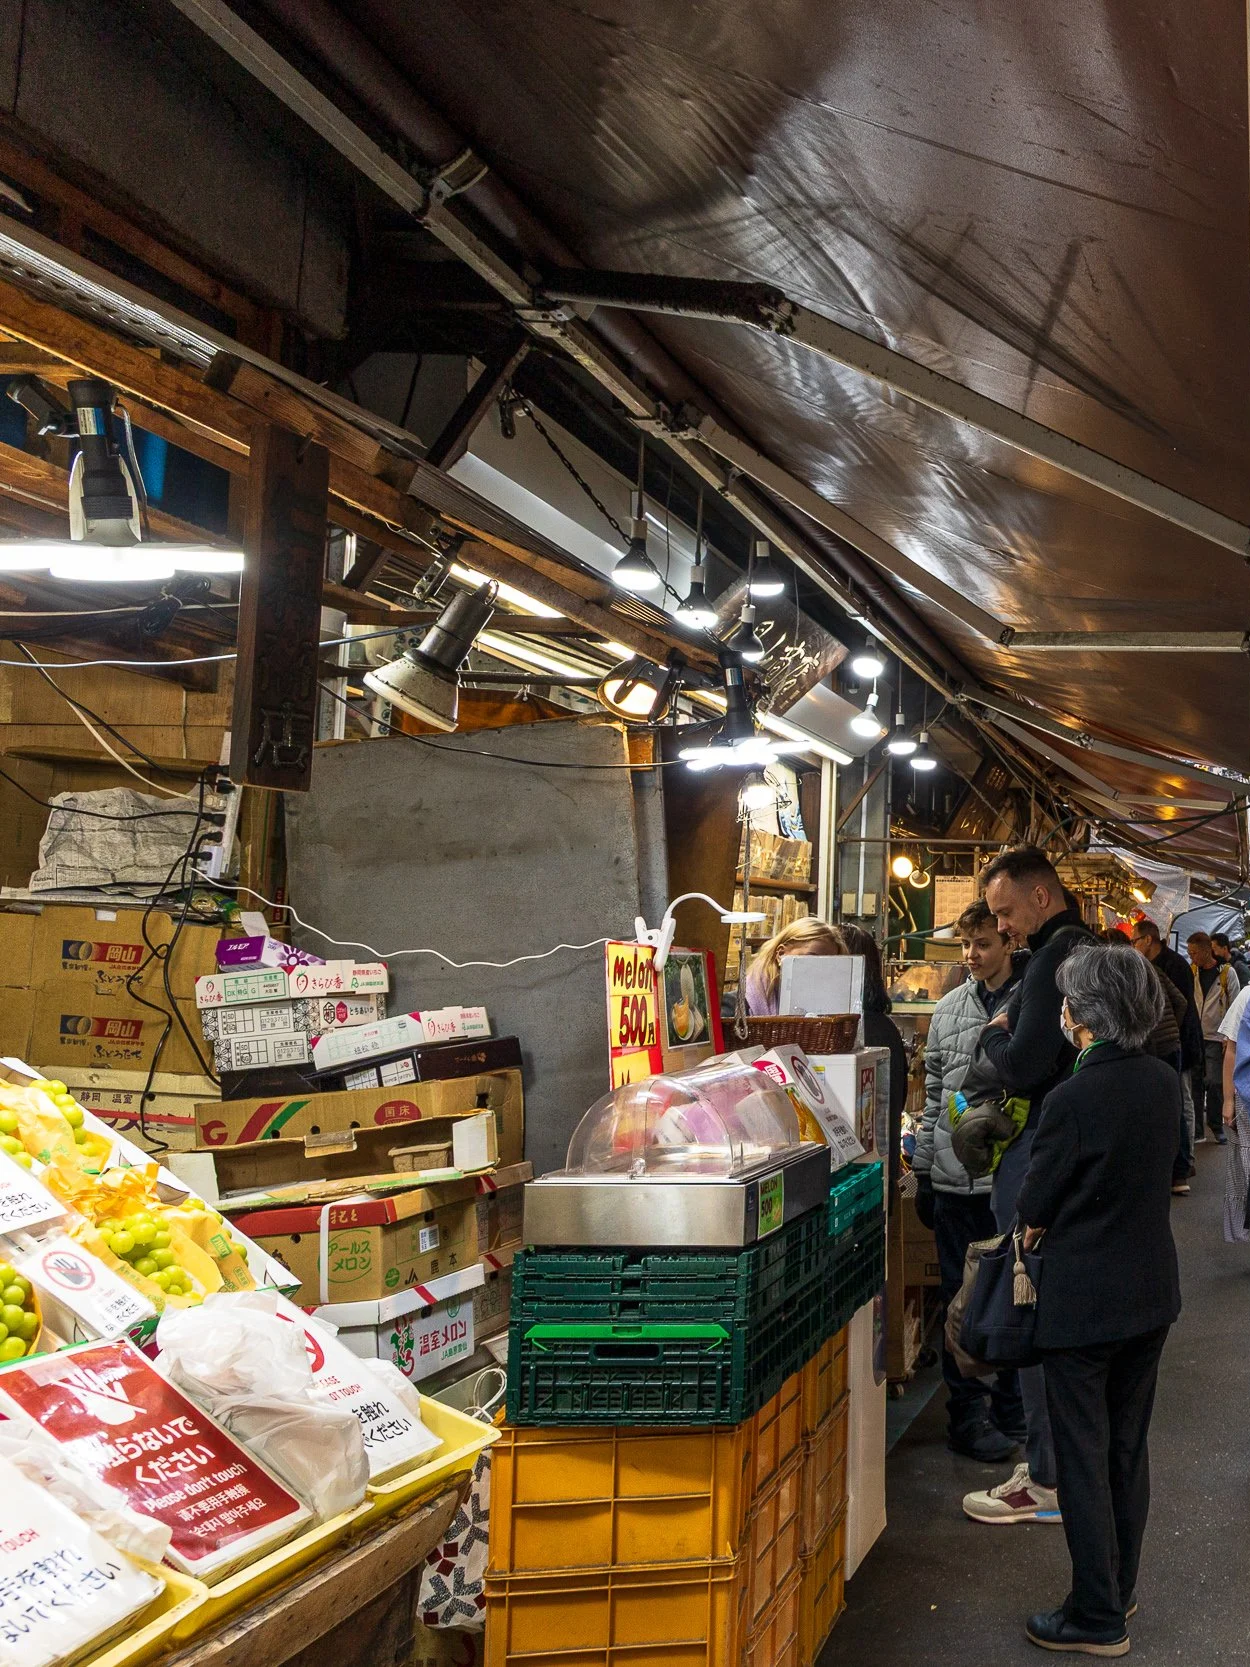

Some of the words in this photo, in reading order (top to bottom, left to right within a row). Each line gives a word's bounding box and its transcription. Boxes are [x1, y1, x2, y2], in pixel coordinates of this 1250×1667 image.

[106, 946, 136, 962] 岡山
[613, 948, 654, 995] Melon
[349, 1006, 374, 1016] とちあいか
[105, 1021, 135, 1037] 岡山
[80, 1092, 100, 1102] 静岡
[112, 1093, 134, 1105] 温室
[316, 1208, 358, 1225] まもと
[327, 1240, 371, 1257] アールス
[332, 1255, 372, 1272] メロン
[340, 1383, 361, 1398] TOUCH
[135, 1443, 216, 1488] ください
[142, 1489, 189, 1513] Please
[184, 1474, 215, 1498] don't
[212, 1462, 248, 1486] touch
[176, 1486, 251, 1523] 请不要用手触摸
[218, 1498, 267, 1526] 말아주세요
